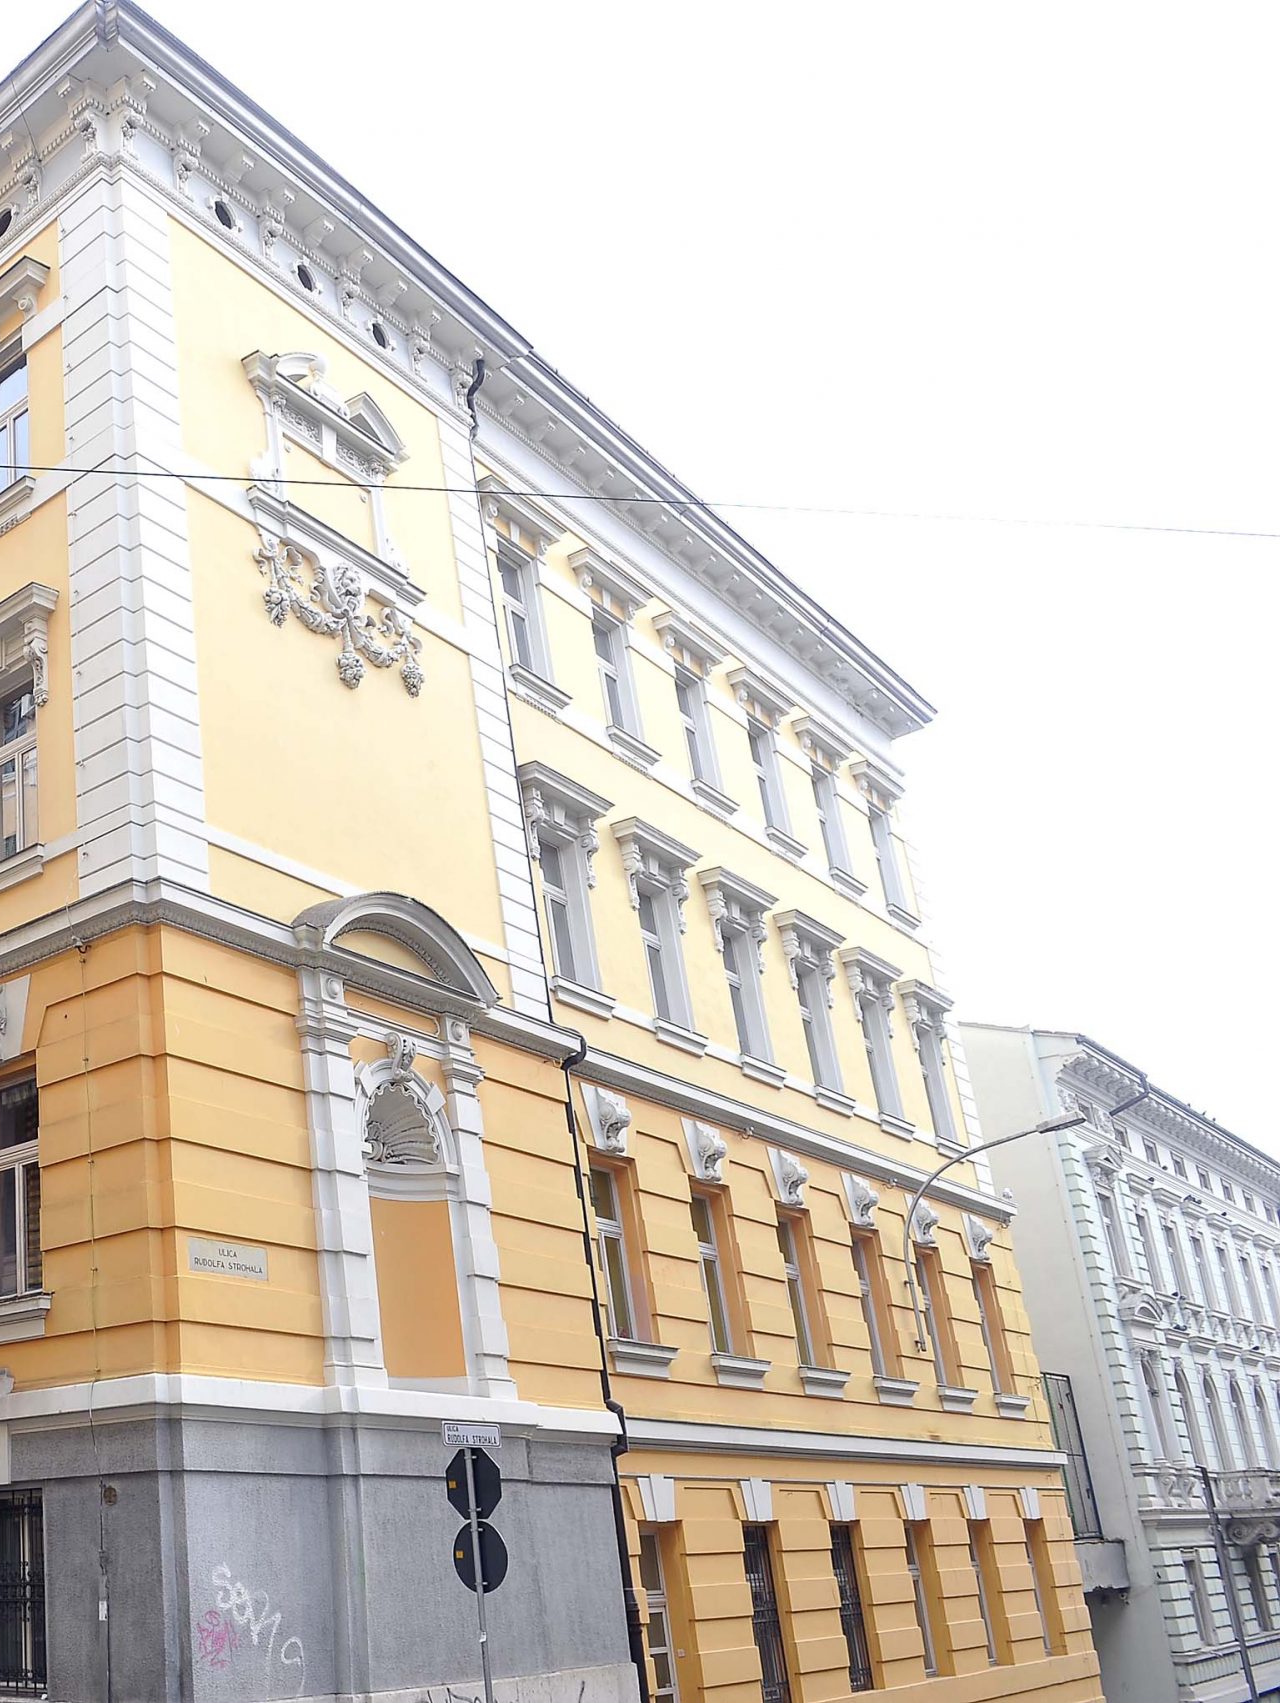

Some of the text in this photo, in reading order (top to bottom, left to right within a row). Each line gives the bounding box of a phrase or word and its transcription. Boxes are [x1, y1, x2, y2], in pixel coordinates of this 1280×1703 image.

[218, 1248, 237, 1257] ULICA
[194, 1257, 263, 1274] RUDOLFA STROHALA
[447, 1434, 497, 1444] RUDOLFA STROHALA
